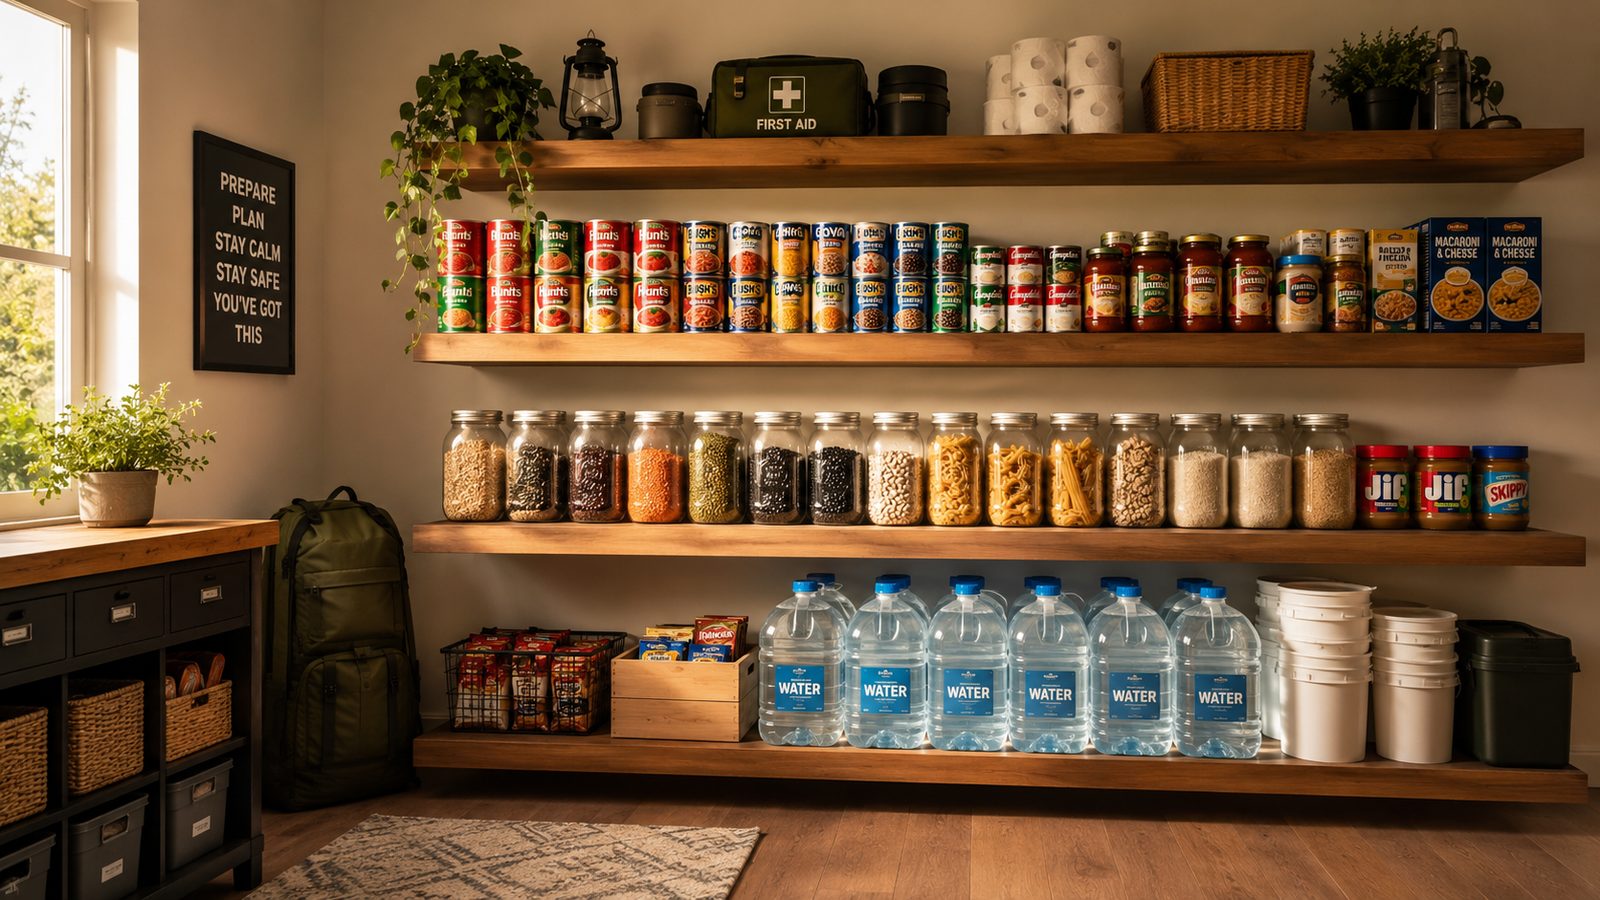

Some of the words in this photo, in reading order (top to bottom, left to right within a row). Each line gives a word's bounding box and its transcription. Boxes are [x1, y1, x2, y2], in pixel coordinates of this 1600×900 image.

[757, 119, 792, 131] FIRST
[795, 119, 818, 131] AID
[220, 171, 277, 205] PREPARE
[232, 205, 265, 231] PLAN
[215, 231, 246, 256] STAY
[249, 239, 281, 263] CALM
[1435, 236, 1481, 248] MACARONI
[1492, 236, 1538, 248] MACARONI
[1437, 248, 1443, 259] &
[216, 262, 248, 285] STAY
[250, 268, 280, 291] SAFE
[214, 291, 257, 316] YOU'VE
[260, 299, 283, 320] GOT
[235, 324, 263, 345] THIS
[1365, 474, 1408, 501] Jif
[1425, 474, 1469, 501] Jif
[1491, 482, 1528, 503] SKIPPY
[778, 682, 821, 696] WATER
[863, 684, 908, 698] WATER
[947, 686, 991, 700] WATER
[1029, 688, 1073, 702] WATER
[1112, 689, 1158, 704] WATER
[1198, 691, 1244, 705] WATER
